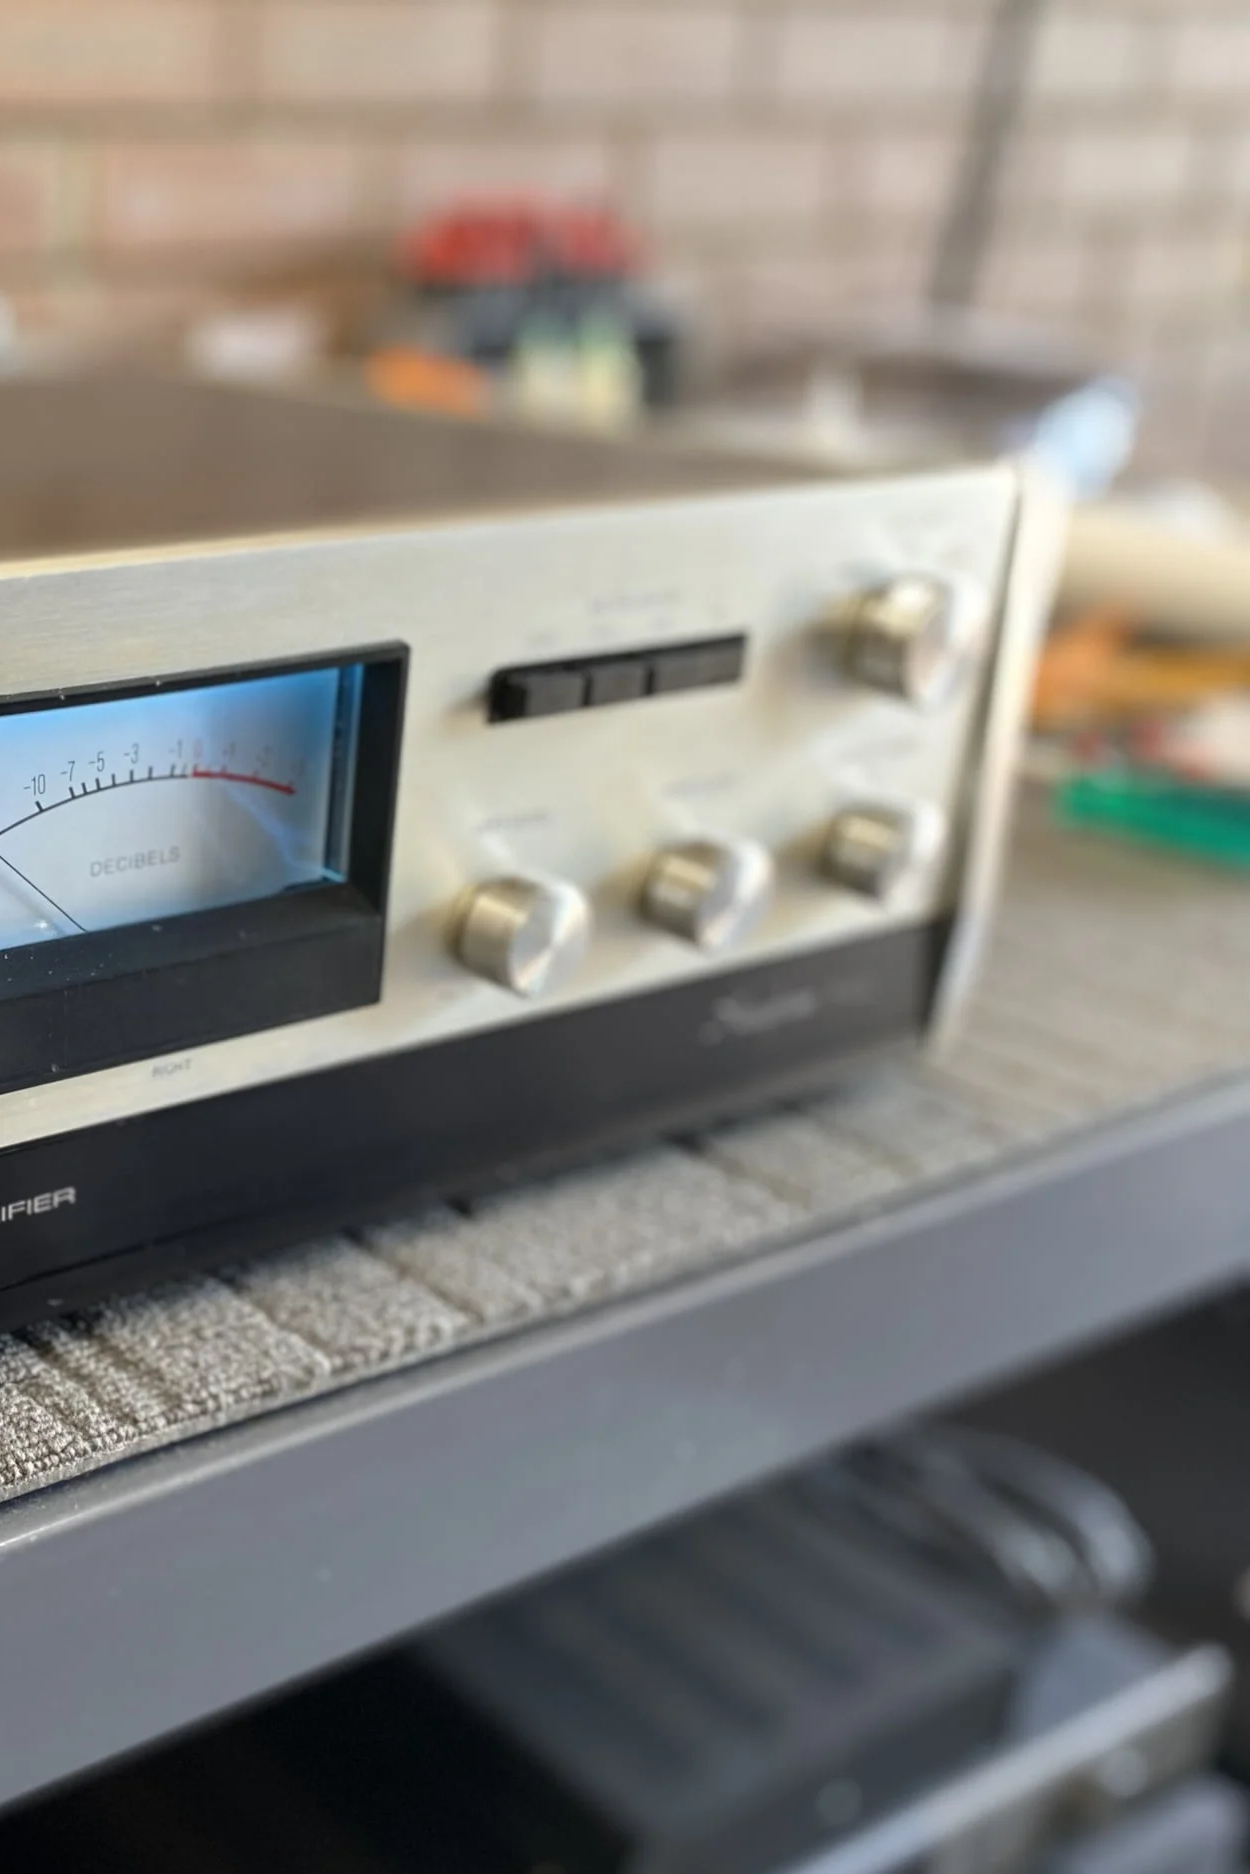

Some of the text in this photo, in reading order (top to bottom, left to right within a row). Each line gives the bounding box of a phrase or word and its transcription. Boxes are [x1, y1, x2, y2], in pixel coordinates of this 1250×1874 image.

[23, 774, 46, 797] -10
[60, 761, 76, 783] -7
[87, 751, 105, 773] -5
[123, 743, 140, 765] -3
[89, 845, 181, 878] DECIBELS
